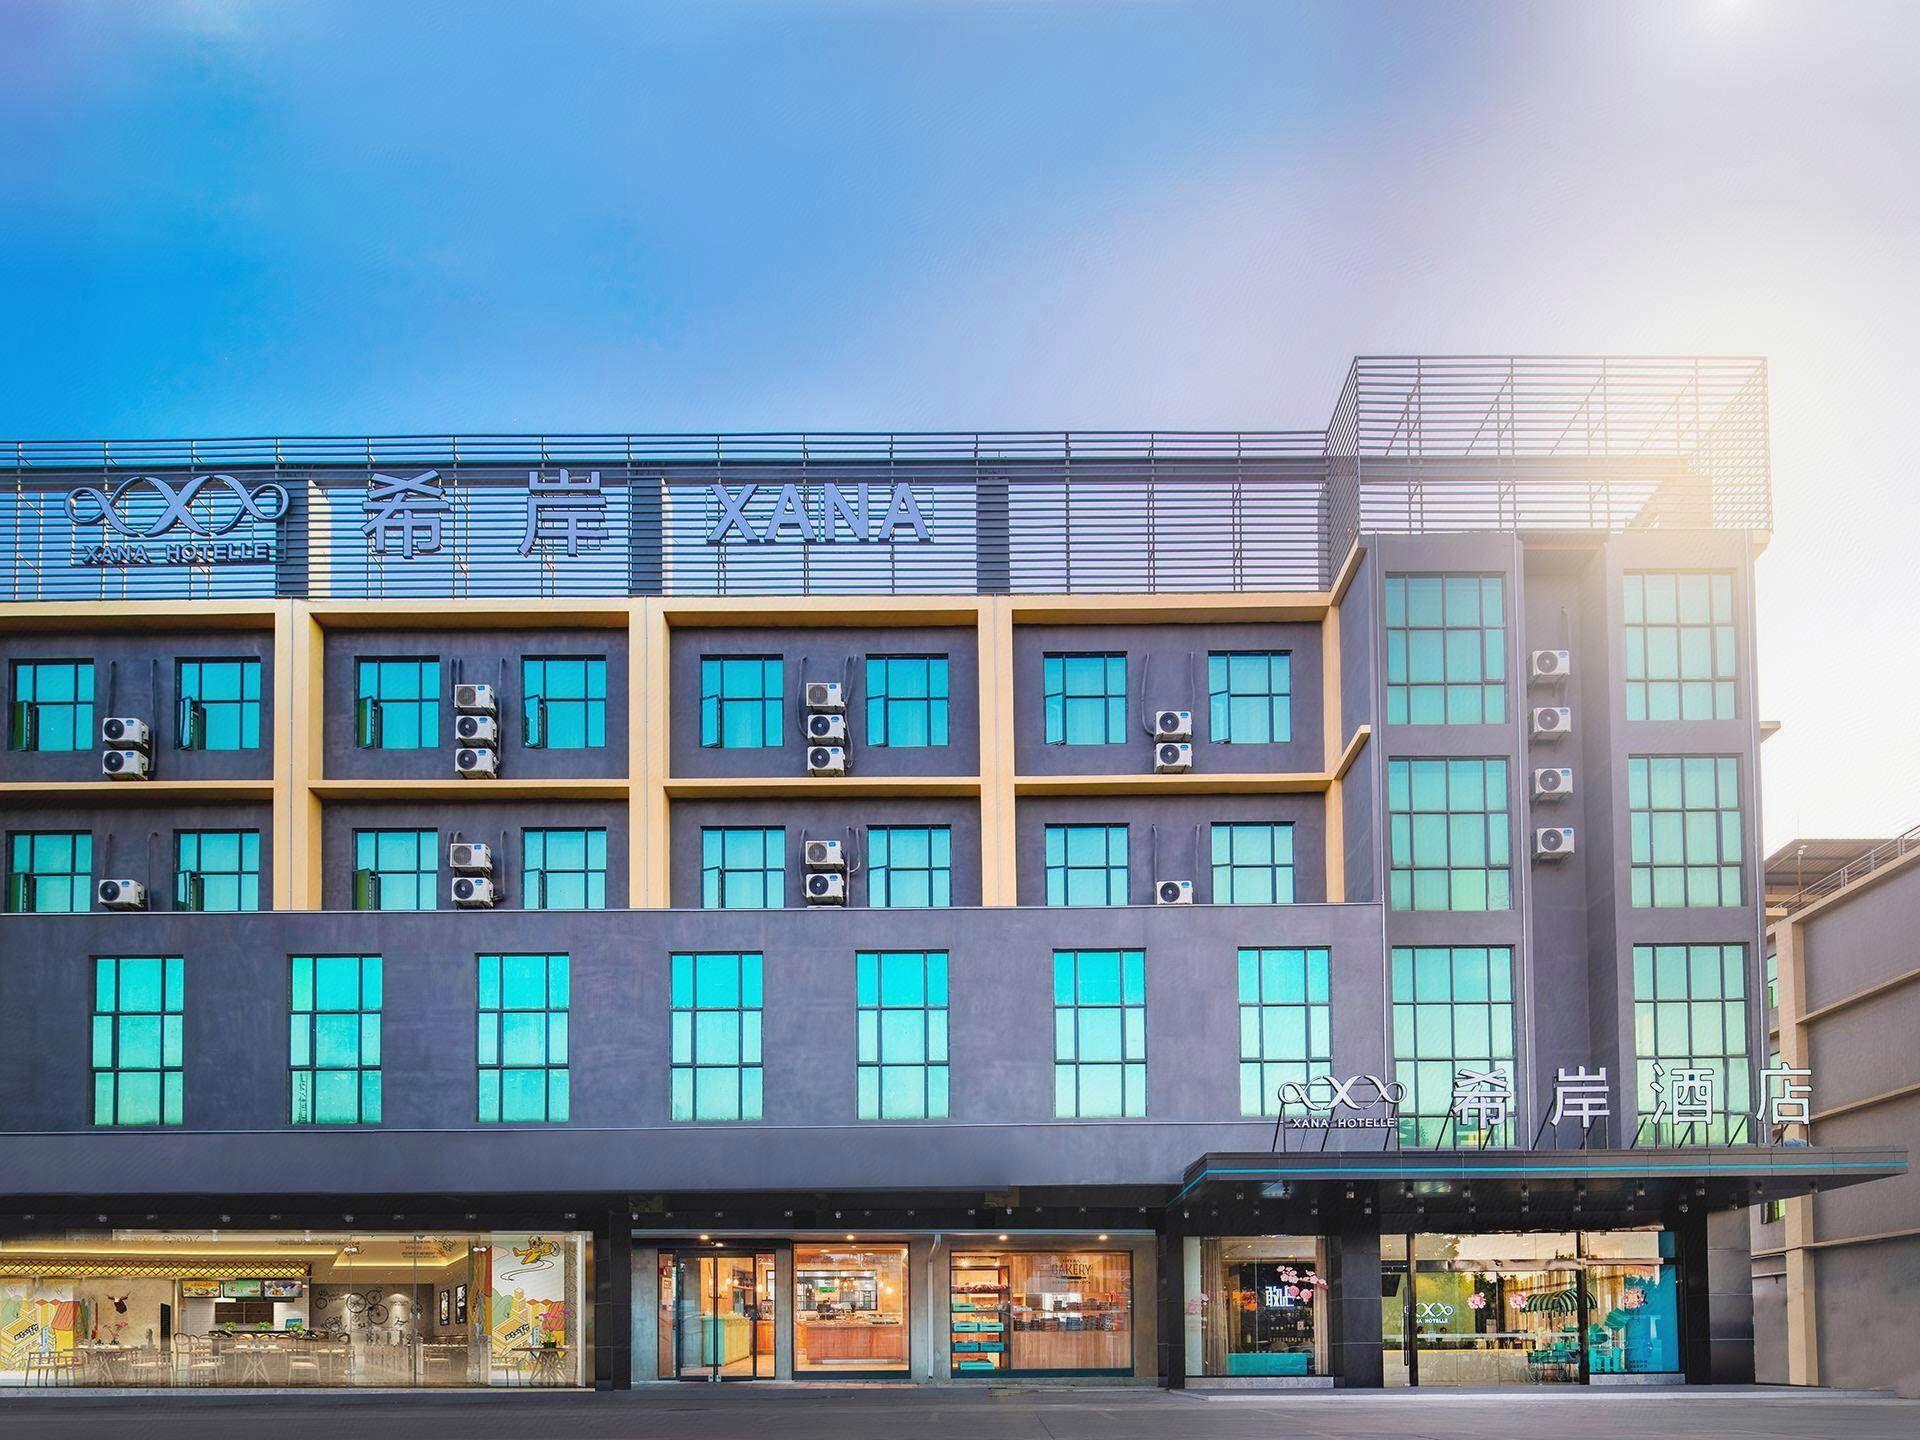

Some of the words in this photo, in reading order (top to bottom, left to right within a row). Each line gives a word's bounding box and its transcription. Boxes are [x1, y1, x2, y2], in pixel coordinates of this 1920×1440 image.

[361, 468, 609, 559] 希岸
[706, 482, 931, 543] XANA
[83, 544, 151, 563] XANA
[165, 542, 270, 562] HOTELLE
[1451, 1062, 1814, 1128] 希岸酒店
[1293, 1118, 1329, 1128] XANA
[1338, 1118, 1395, 1128] HOTELLE
[1052, 1264, 1091, 1275] BAKERY
